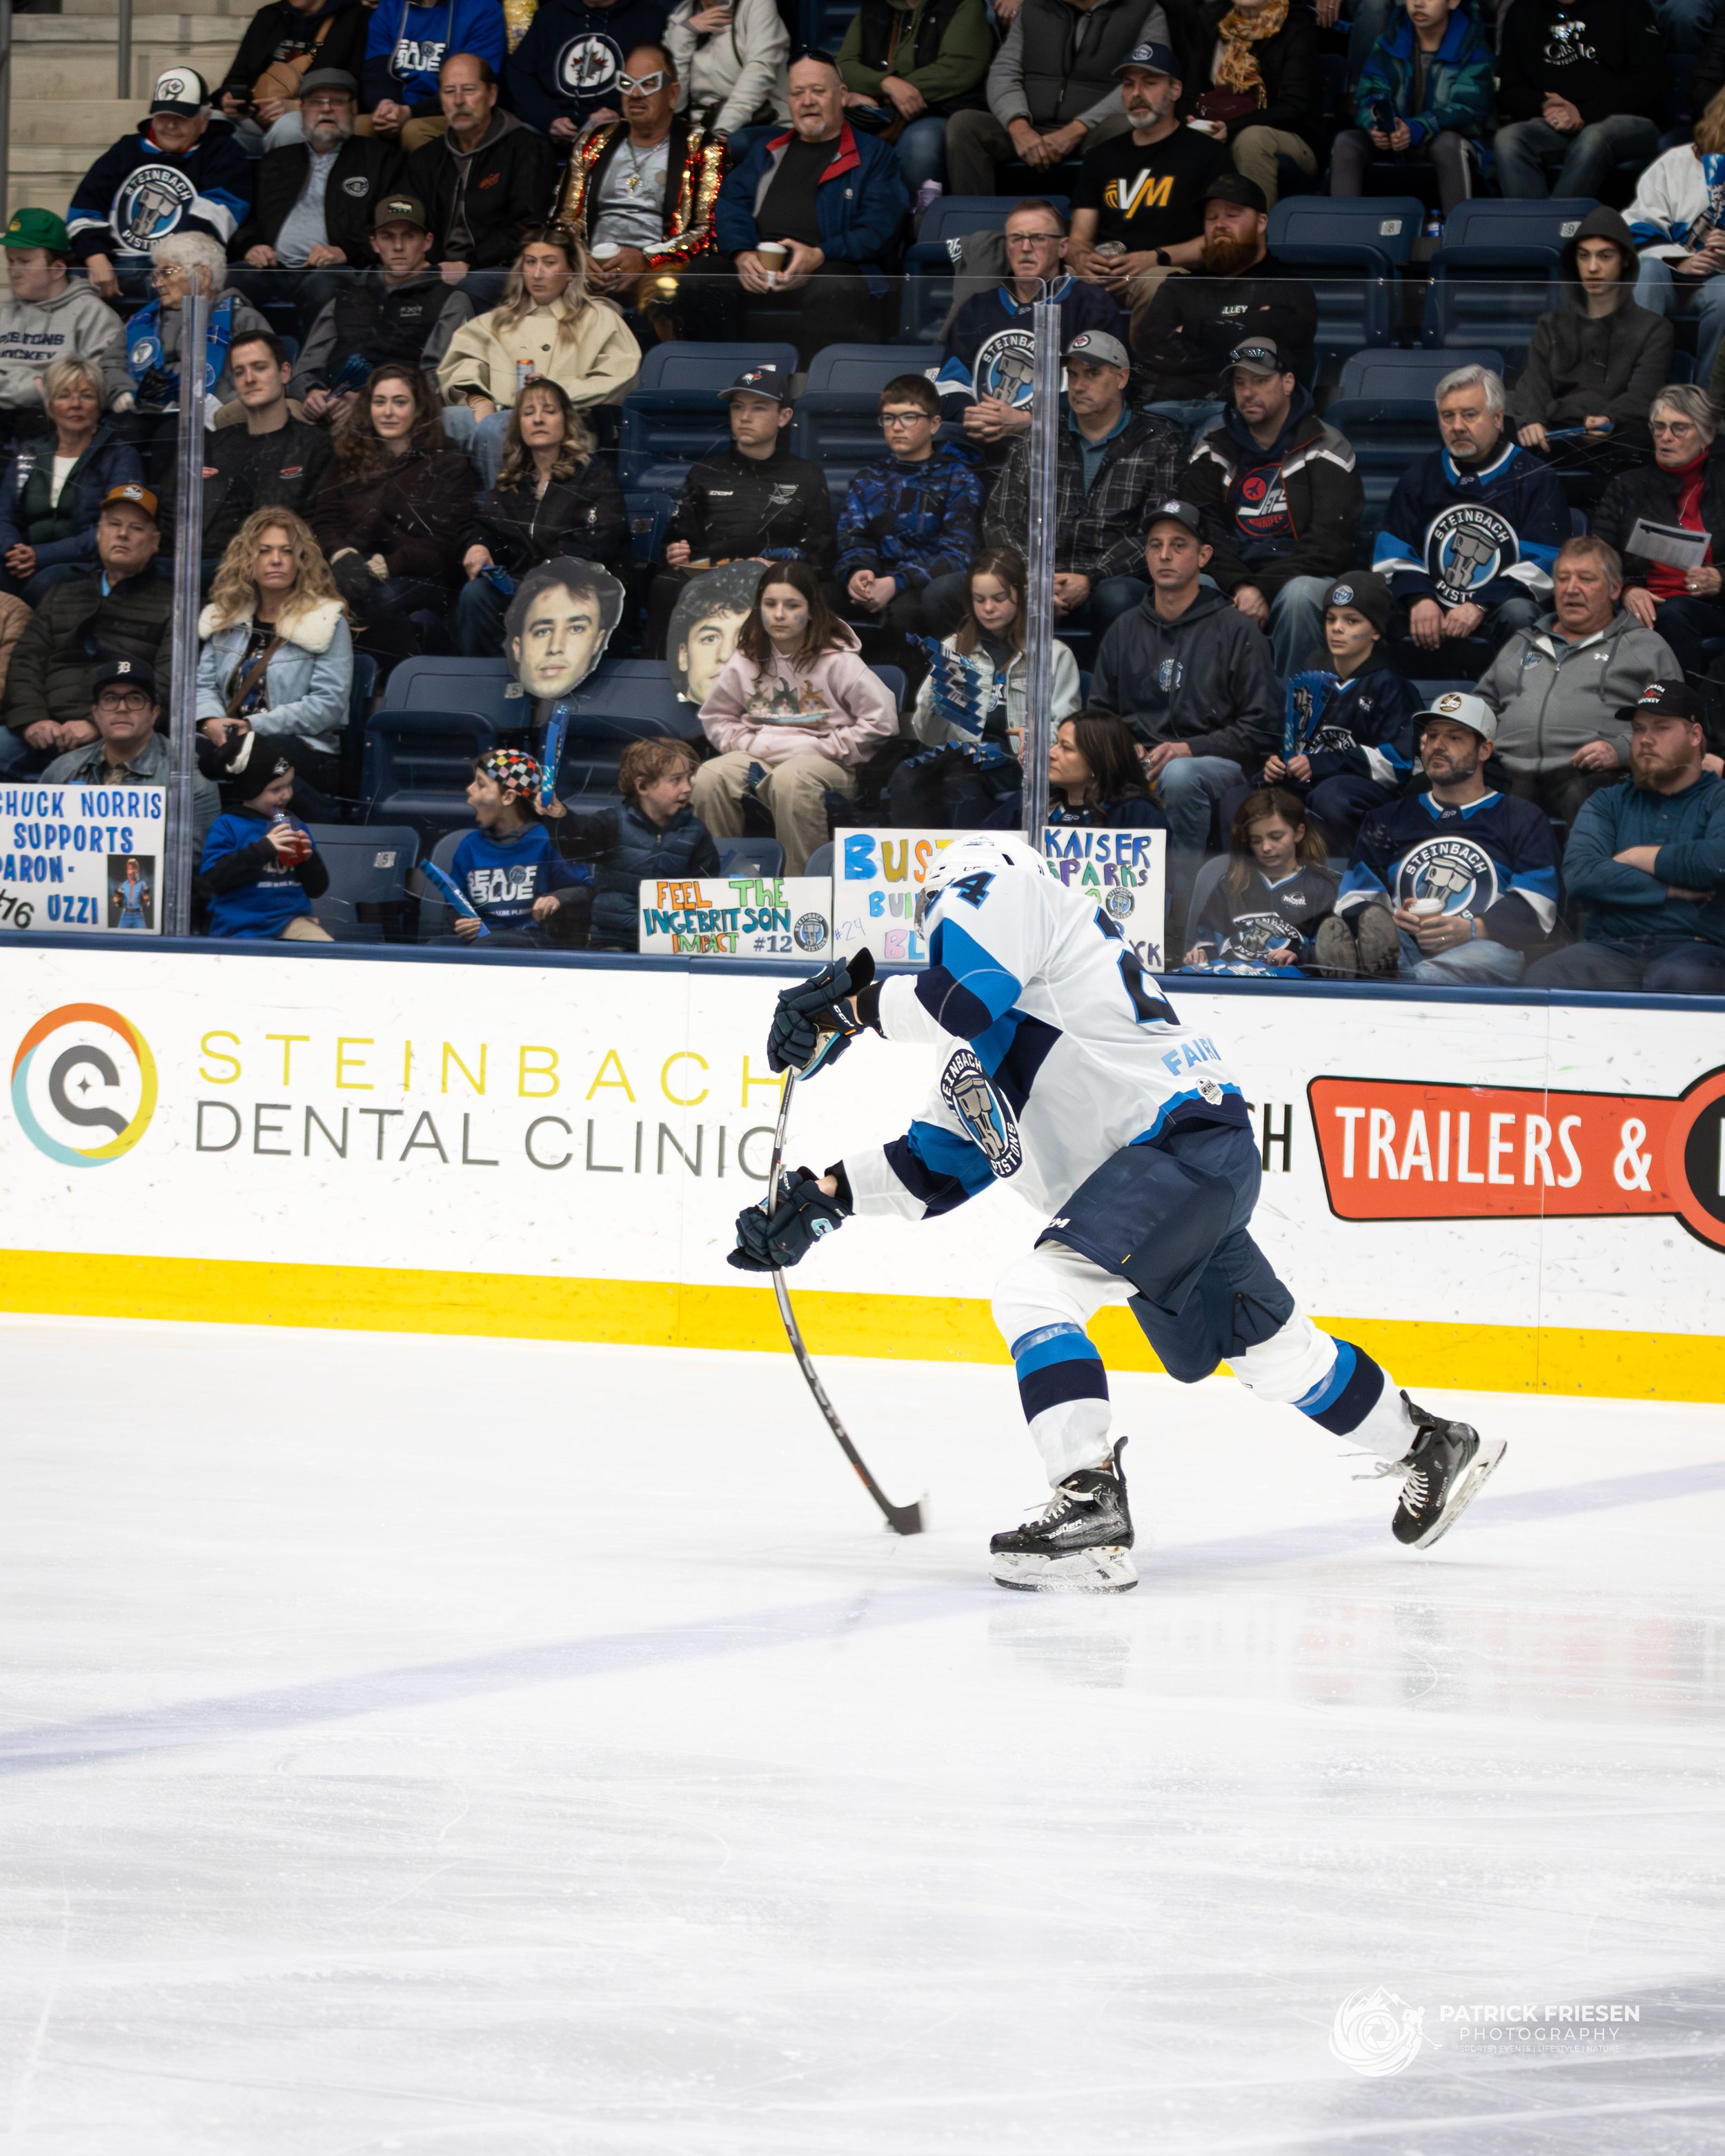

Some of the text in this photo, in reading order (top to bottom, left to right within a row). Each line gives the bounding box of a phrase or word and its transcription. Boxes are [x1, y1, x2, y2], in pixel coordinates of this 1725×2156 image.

[124, 170, 193, 201] STEINBACH
[121, 229, 161, 250] PIST
[1221, 305, 1248, 315] LLEY
[0, 349, 56, 360] OCKEY
[983, 335, 1034, 364] STEINBA
[1435, 509, 1510, 544] STEINBACH
[1437, 579, 1477, 603] PIST
[0, 790, 161, 820] HUCK NORRIS
[14, 822, 133, 853] SUPPORTS
[1044, 829, 1151, 869] KAISER
[0, 853, 75, 883] ARON-
[1405, 843, 1487, 876] STEINBACH
[469, 882, 534, 904] BLUE
[657, 881, 712, 910] FEEL
[48, 894, 98, 924] UZZI
[794, 913, 825, 932] STEINBACH
[671, 932, 793, 953] IMPACT #12
[804, 936, 828, 952] PISTONS
[835, 918, 867, 942] #24
[833, 1005, 855, 1028] CCM
[197, 1029, 789, 1108] STEINBACH
[942, 1053, 983, 1118] TEINBACH
[196, 1100, 787, 1183] DENTAL CLINIC
[991, 1122, 1021, 1175] PISTONS
[1335, 1106, 1582, 1189] TRAILERS
[1613, 1118, 1653, 1192] &
